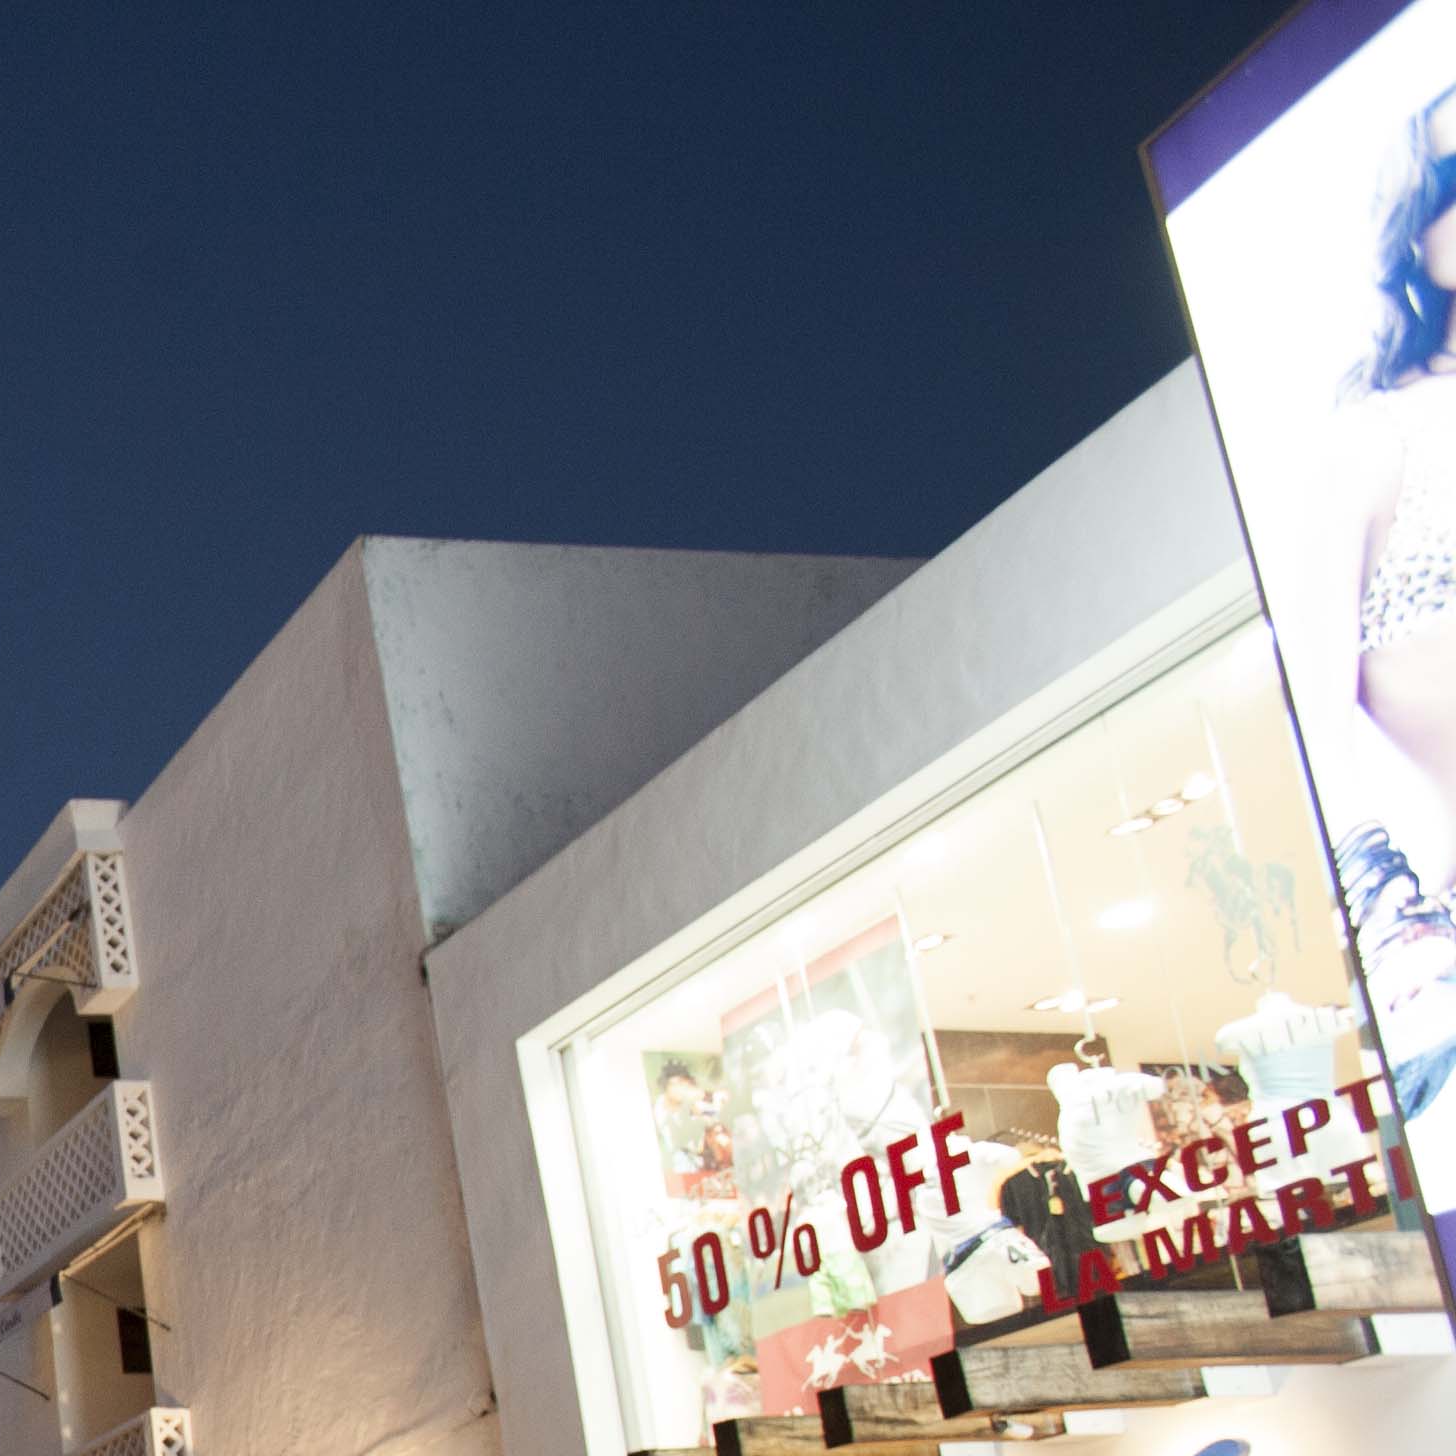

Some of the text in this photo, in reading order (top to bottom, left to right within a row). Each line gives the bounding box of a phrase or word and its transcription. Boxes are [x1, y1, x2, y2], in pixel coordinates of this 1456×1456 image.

[842, 1112, 972, 1253] OFF
[1088, 1074, 1385, 1226] EXCEPT
[1037, 1248, 1122, 1313] LA
